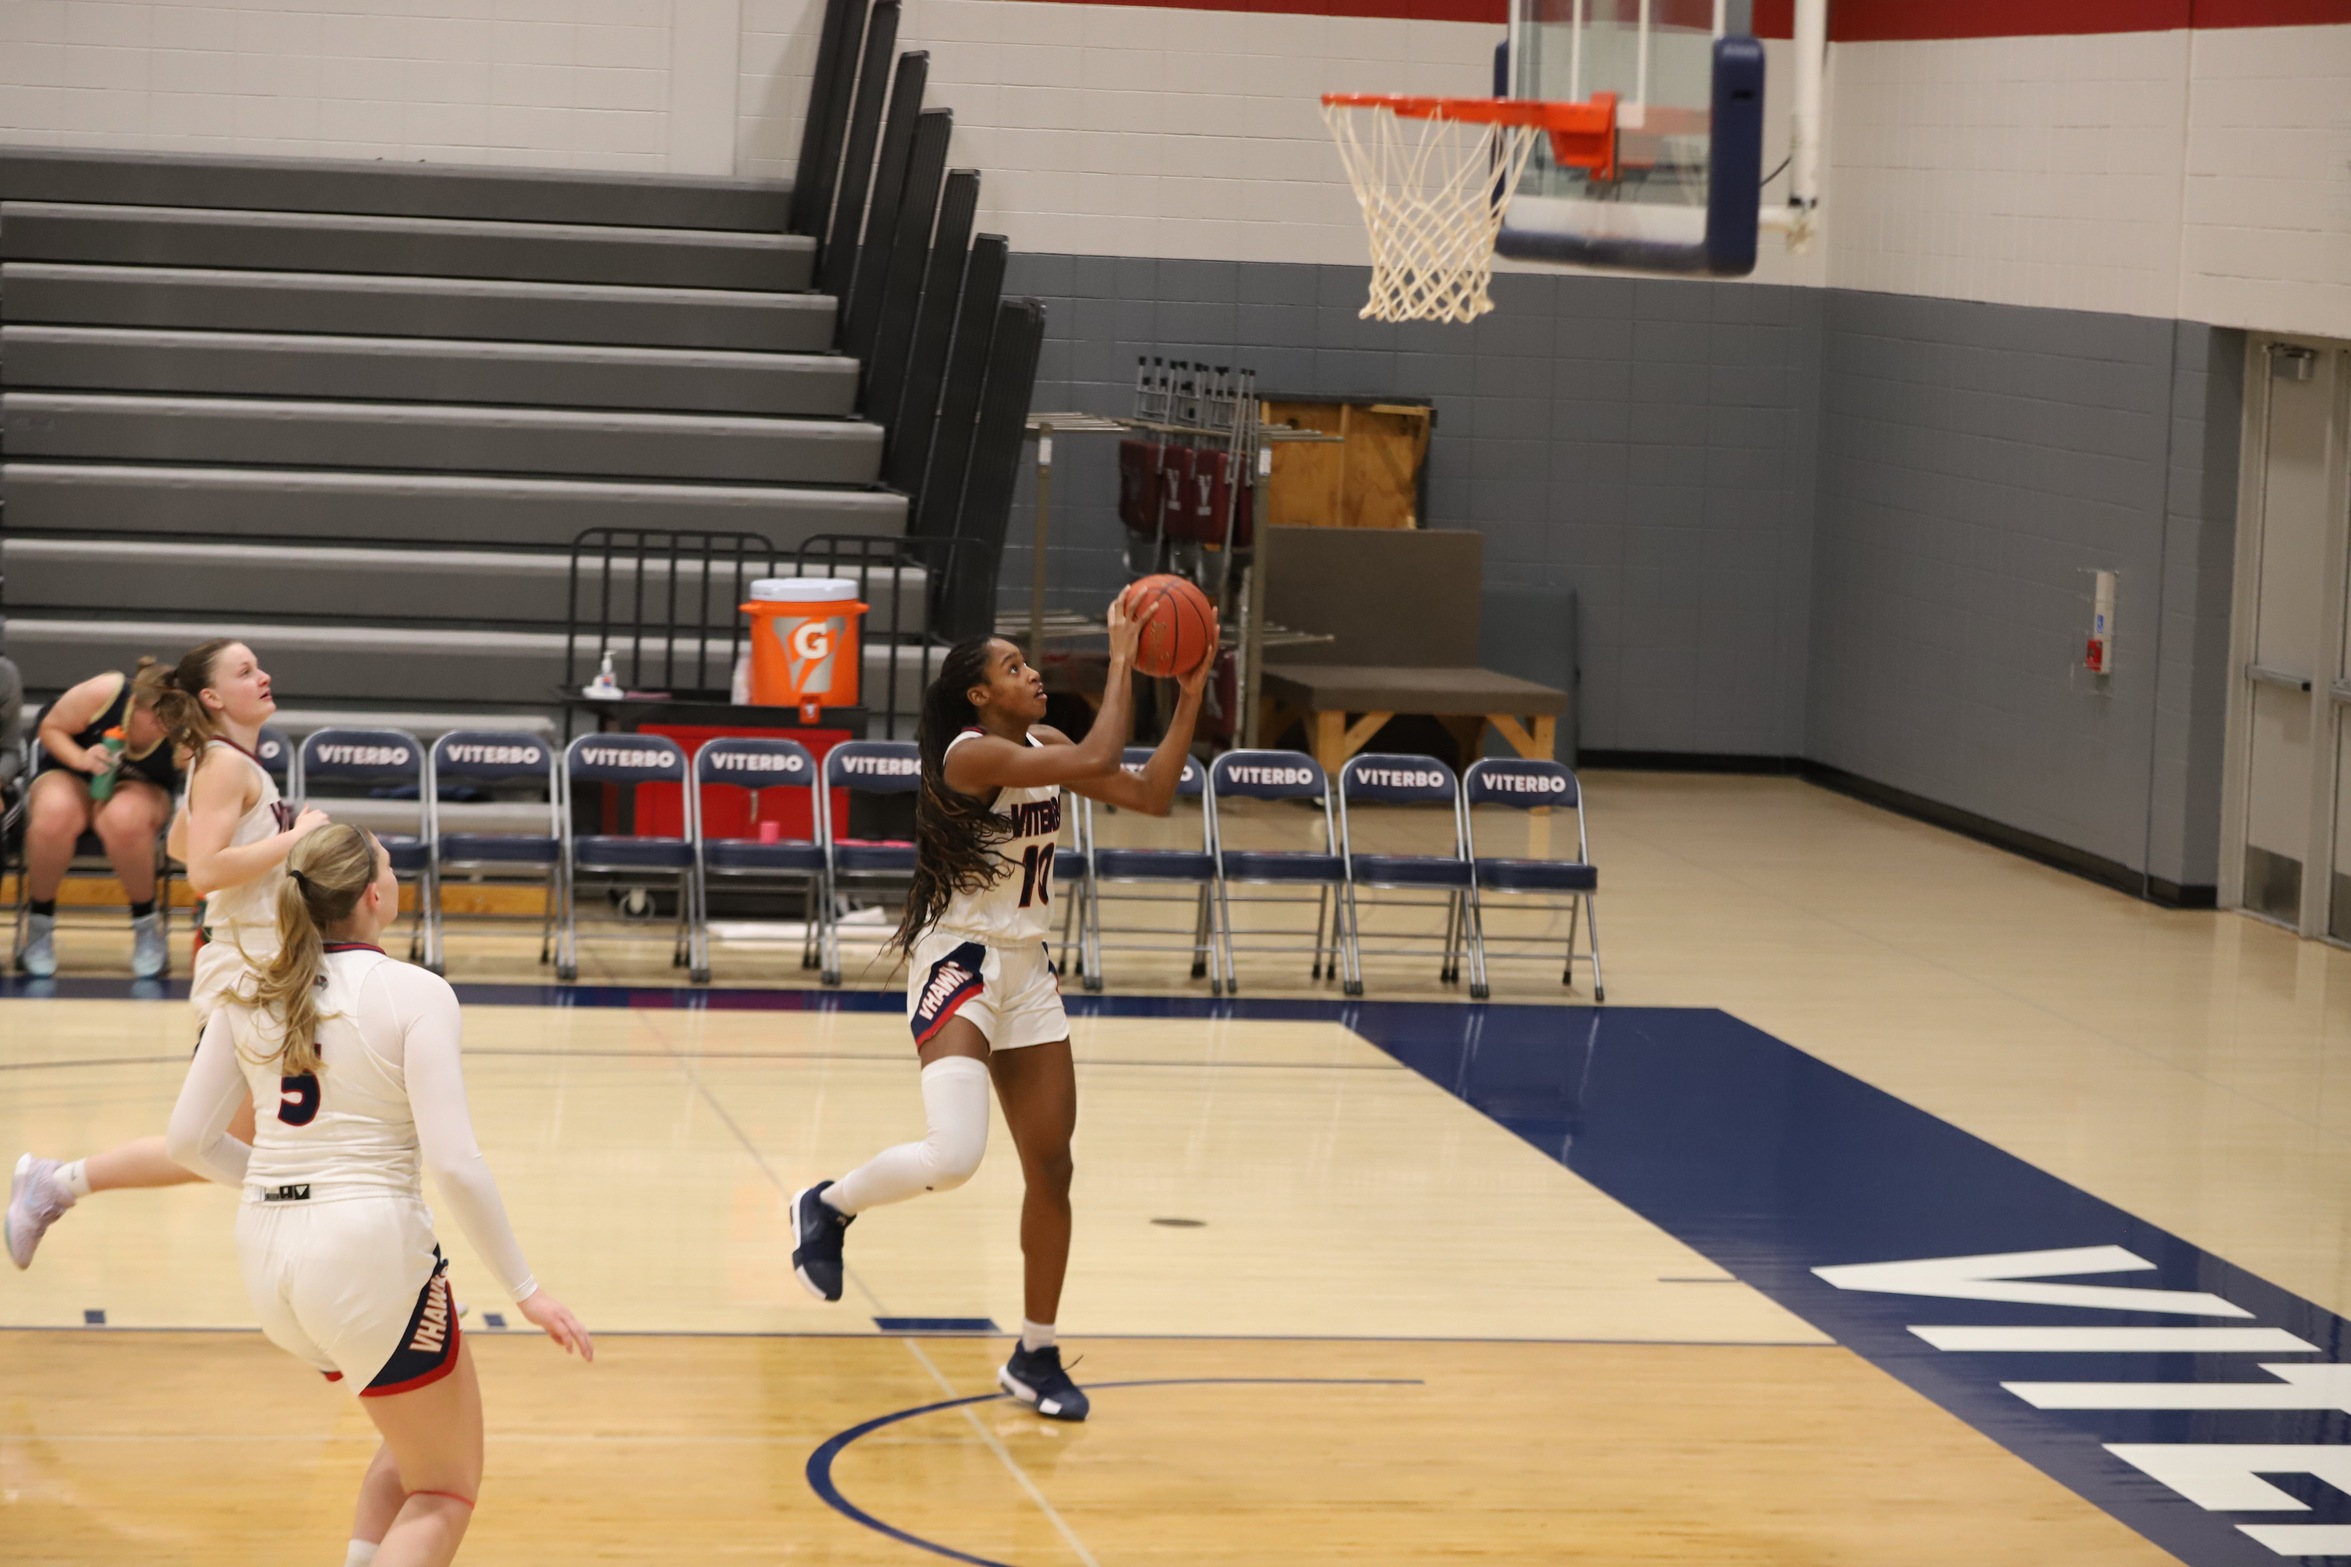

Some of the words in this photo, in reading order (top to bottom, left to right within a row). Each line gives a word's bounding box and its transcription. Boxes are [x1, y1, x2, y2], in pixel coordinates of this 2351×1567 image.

[795, 622, 828, 659] G
[316, 744, 410, 766] VITERBO
[445, 744, 541, 765] VITERBO
[580, 747, 676, 769] VITERBO
[710, 752, 804, 773] VITERBO
[1227, 765, 1313, 785] VITERBO
[1356, 768, 1445, 788] VITERBO
[1482, 773, 1566, 793] VITERBO
[1018, 842, 1055, 908] 10
[277, 1043, 322, 1127] 5
